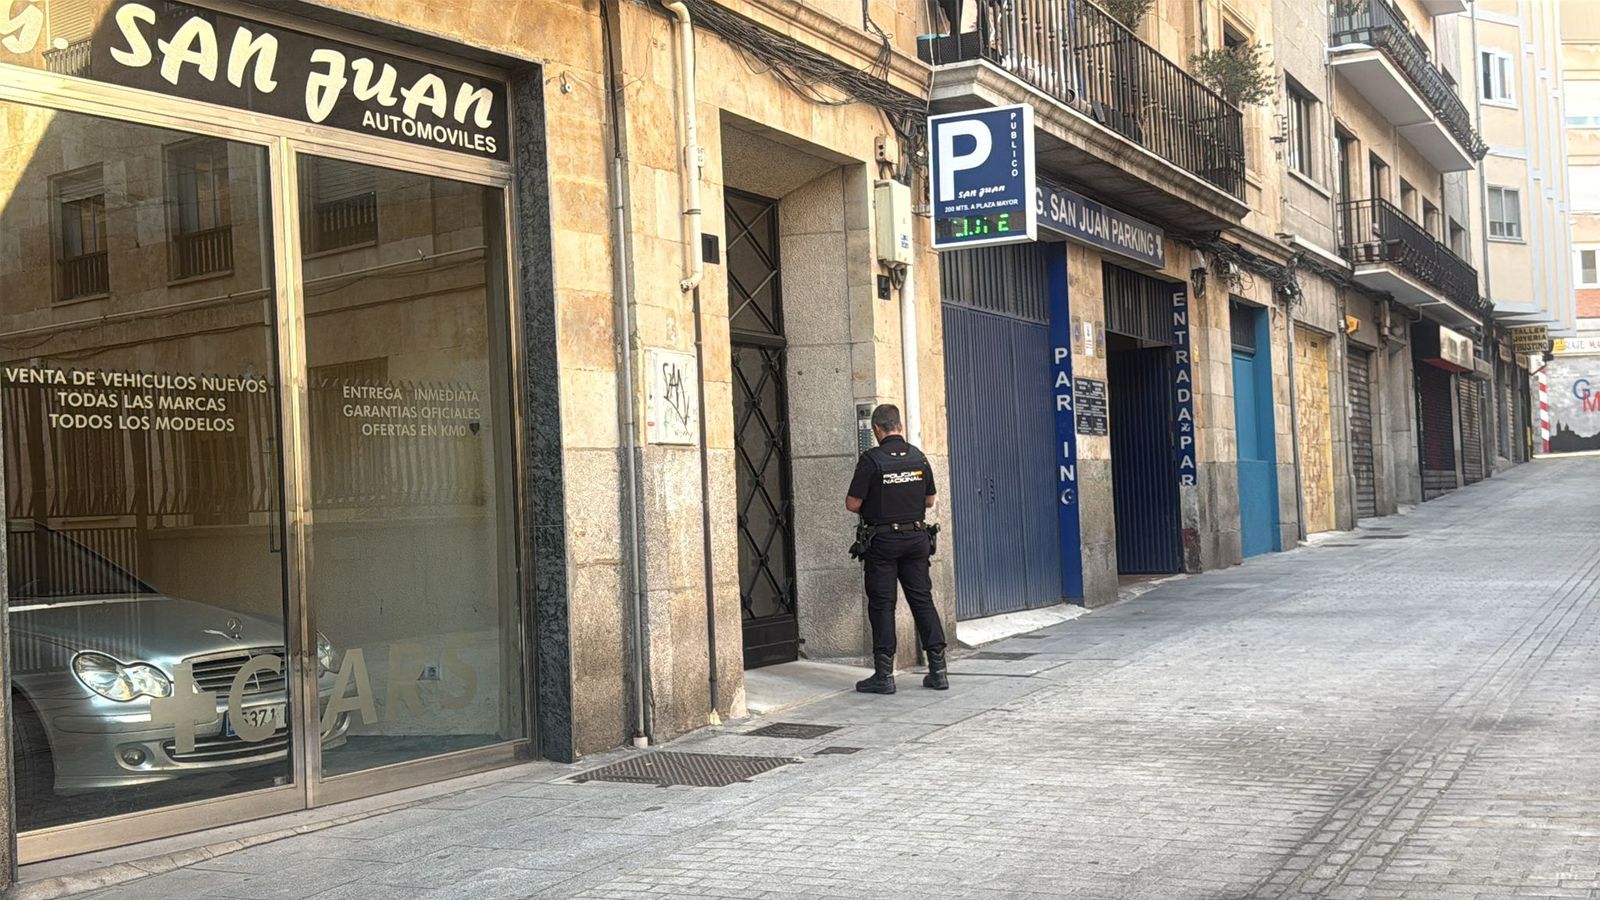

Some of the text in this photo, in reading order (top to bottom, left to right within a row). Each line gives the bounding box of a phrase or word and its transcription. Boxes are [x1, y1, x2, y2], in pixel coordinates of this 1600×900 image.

[110, 3, 278, 93] SAN
[305, 49, 494, 129] JUAN
[362, 110, 497, 154] AUTOMOVILES
[1010, 112, 1018, 177] PUBLICO
[938, 119, 992, 202] P
[976, 201, 996, 209] PLAZA
[996, 198, 1019, 207] MAYOR
[1050, 193, 1076, 228] SAN
[1079, 206, 1110, 240] JUAN
[1112, 218, 1154, 257] PARKING
[1172, 292, 1191, 421] ENTRADA
[5, 367, 268, 393] VENTA DE VEHICULOS NUEVOS
[343, 385, 480, 402] ENTREGA INMEDIATA
[1054, 347, 1072, 411] PAR
[57, 391, 226, 412] TODAS LAS MARCAS
[343, 404, 481, 420] GARANTIAS OFICIALES
[49, 413, 235, 432] TODOS LOS MODELOS
[361, 423, 417, 436] OFERTAS
[420, 424, 437, 436] EN
